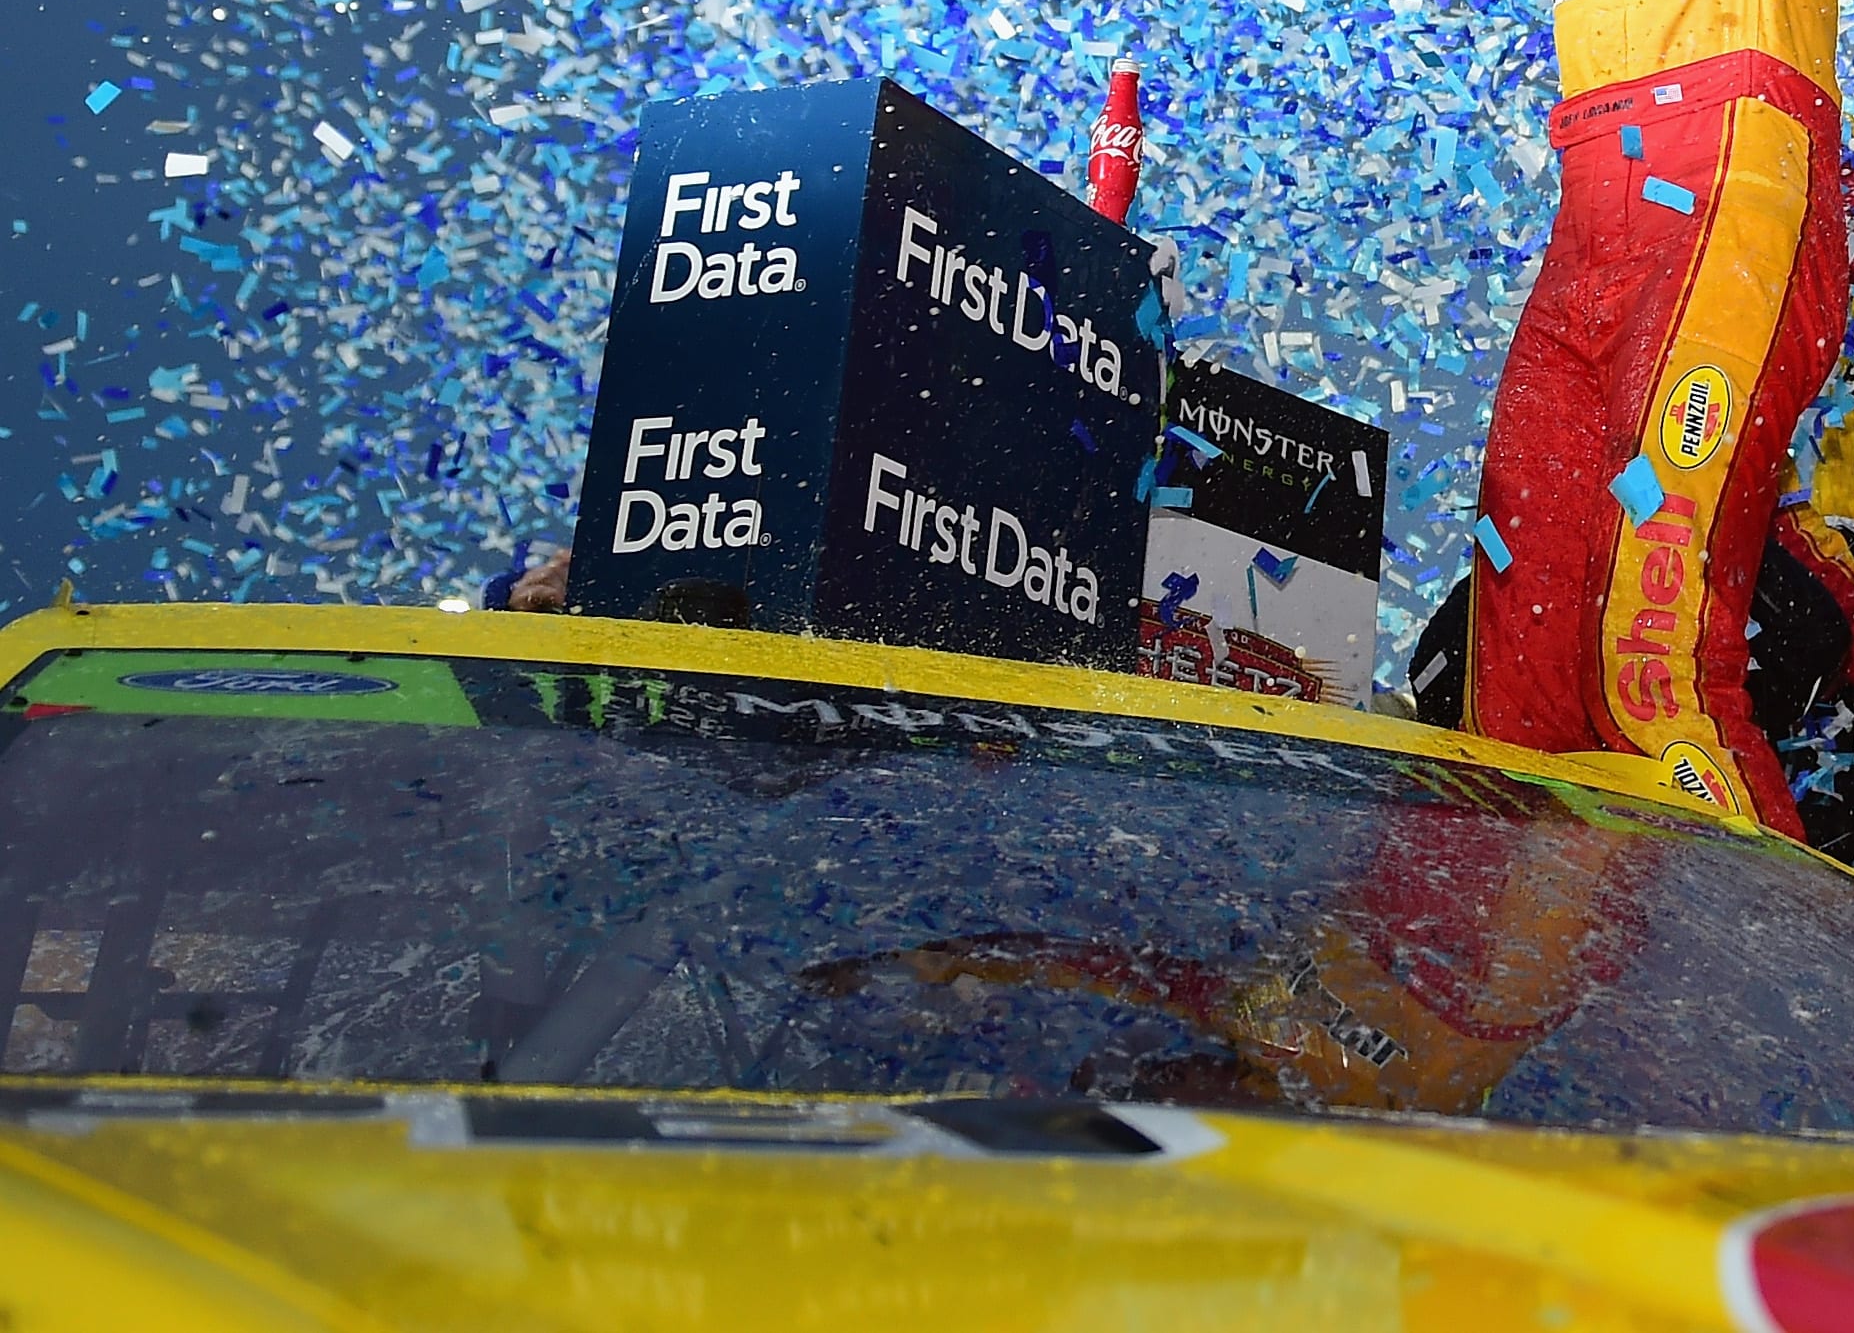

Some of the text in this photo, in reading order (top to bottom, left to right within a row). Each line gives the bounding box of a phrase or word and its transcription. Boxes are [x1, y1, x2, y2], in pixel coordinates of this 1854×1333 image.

[660, 170, 801, 237] First
[649, 241, 799, 304] Data
[896, 206, 1122, 397] First Data
[623, 417, 766, 484] First
[1179, 397, 1337, 481] MONSTER
[1681, 379, 1708, 458] PENNZOIL
[1221, 451, 1313, 492] NERGY
[611, 489, 763, 554] Data
[864, 453, 1099, 626] First Data
[1616, 491, 1697, 723] Shell
[174, 668, 342, 693] Ford
